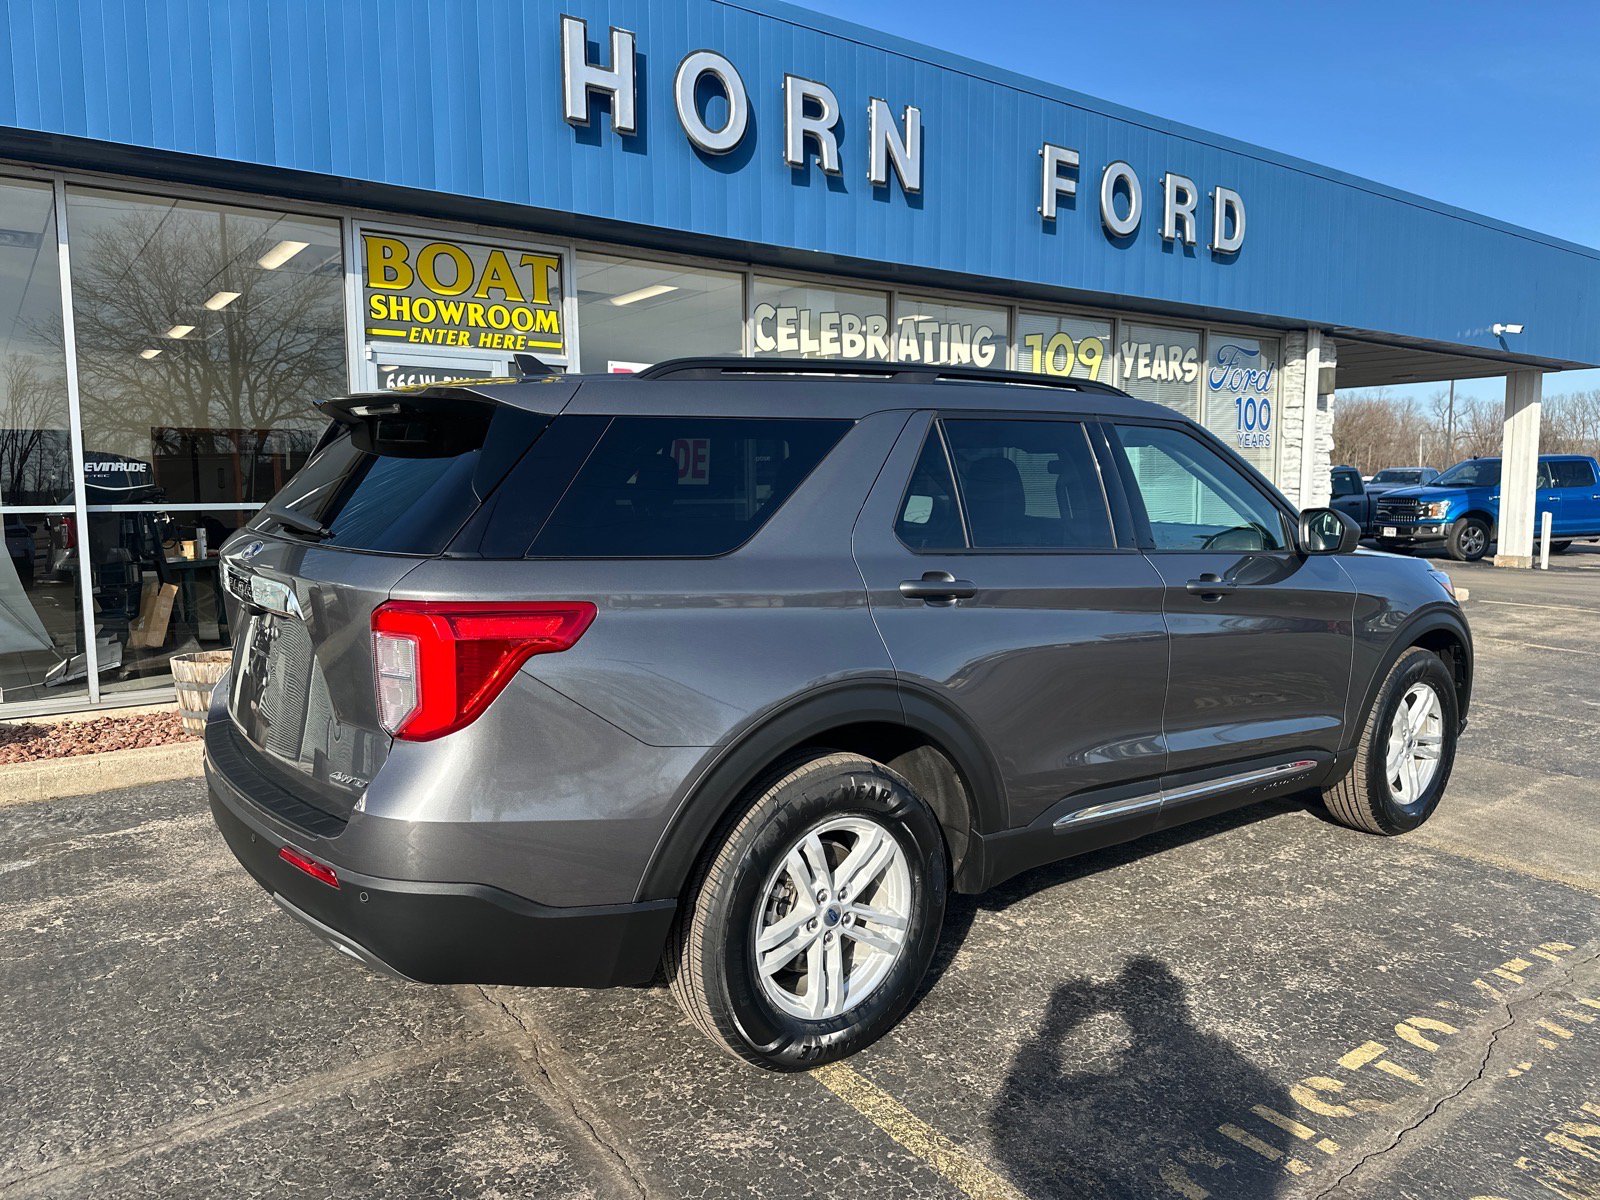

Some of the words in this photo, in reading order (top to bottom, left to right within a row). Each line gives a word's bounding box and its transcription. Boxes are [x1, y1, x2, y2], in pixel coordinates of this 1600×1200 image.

[560, 14, 921, 193] HORN
[1040, 142, 1247, 255] FORD
[362, 235, 559, 305] BOAT
[369, 294, 561, 334] SHOWROOM
[409, 327, 470, 346] ENTER
[478, 333, 527, 350] HERE
[754, 303, 996, 367] CELEBRATING
[1025, 332, 1104, 381] 109
[1120, 341, 1198, 383] YEARS
[1209, 344, 1274, 394] Ford
[1235, 396, 1272, 432] 100
[1237, 433, 1271, 447] YEARS
[84, 462, 147, 472] EVINRUDE
